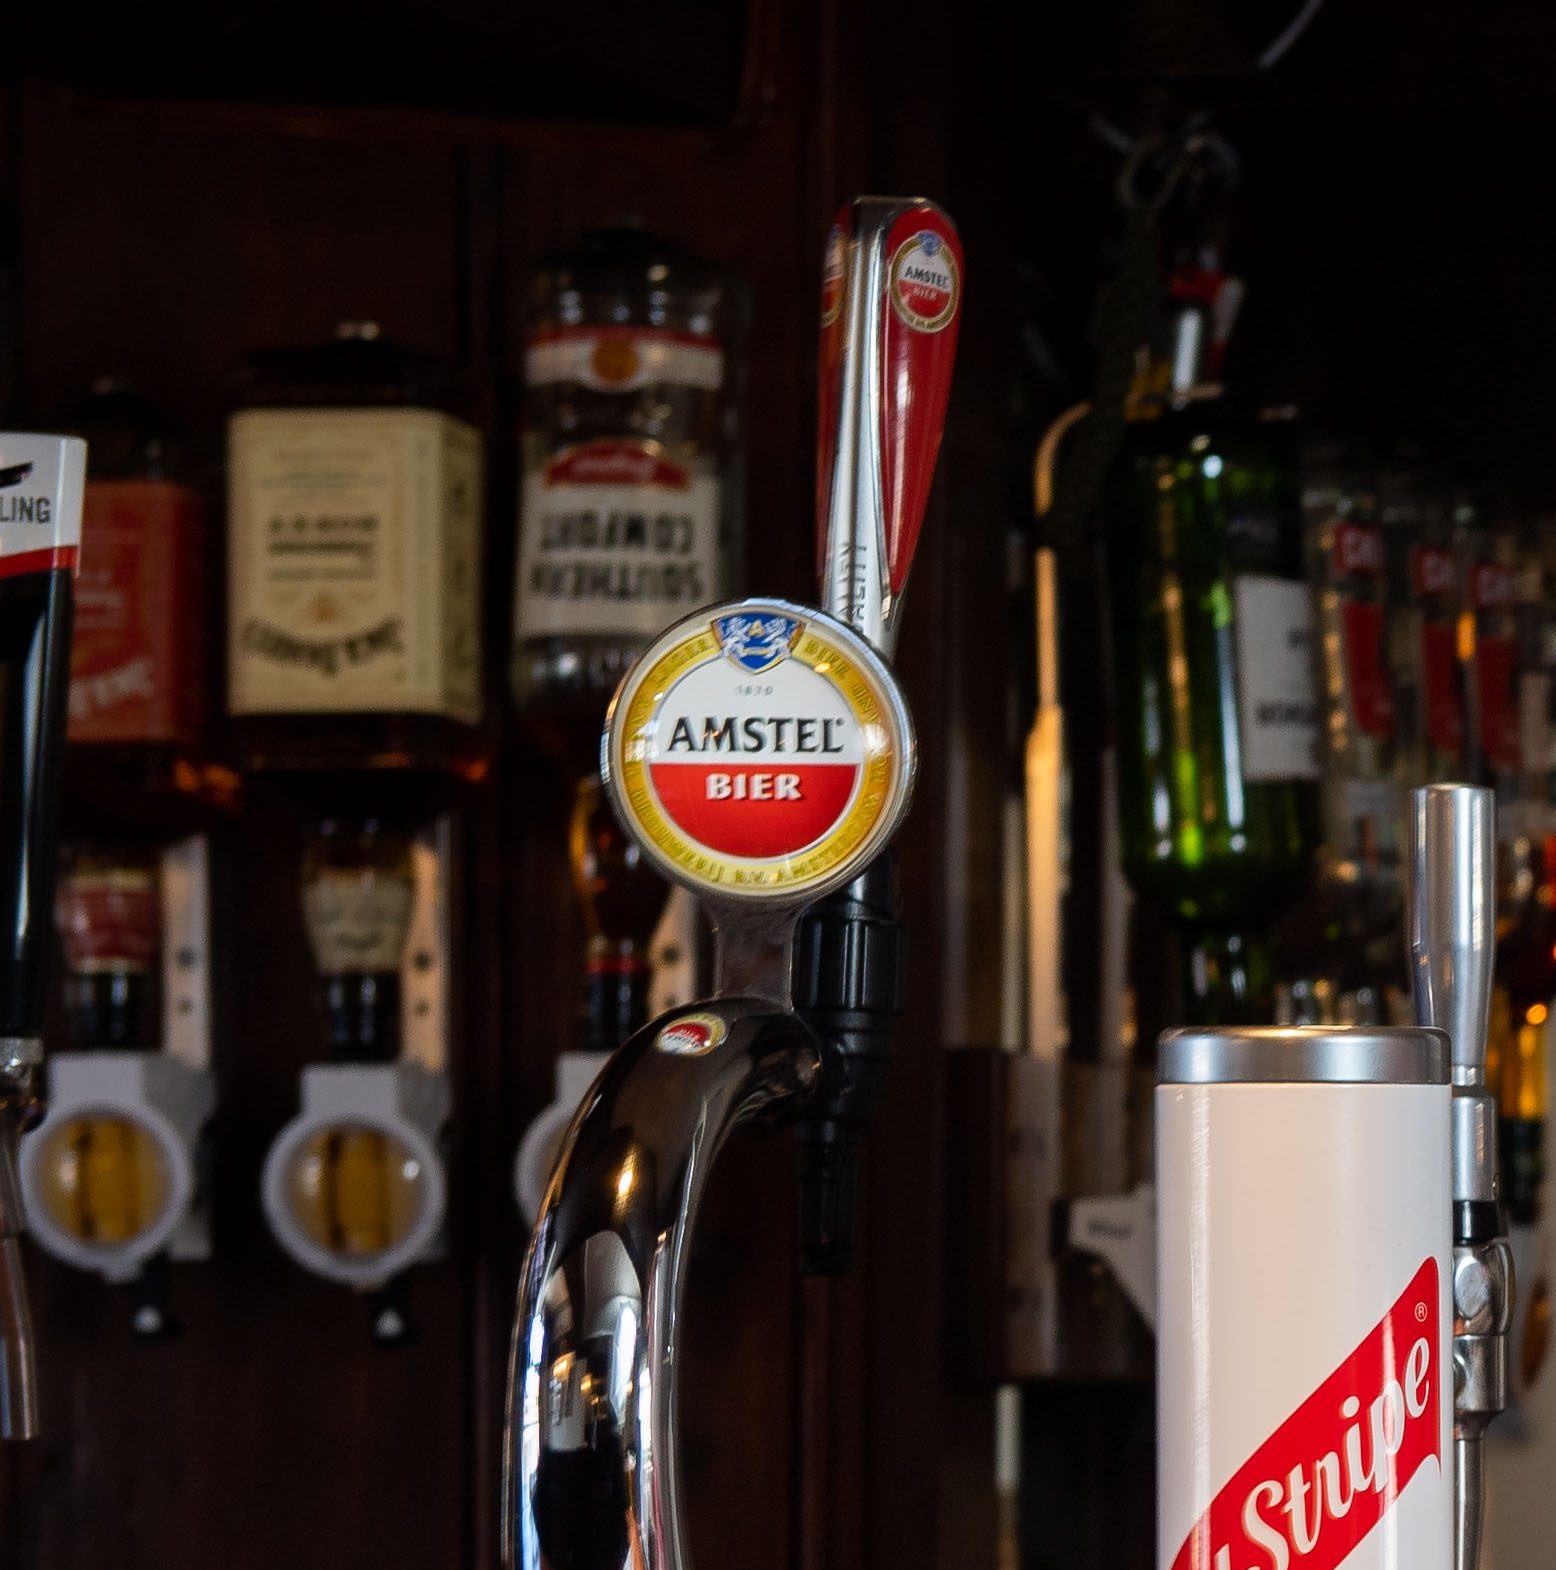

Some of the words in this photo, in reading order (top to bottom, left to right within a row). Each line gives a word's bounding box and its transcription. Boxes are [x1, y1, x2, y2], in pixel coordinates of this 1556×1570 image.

[905, 266, 949, 289] AMSTEL
[666, 716, 845, 754] AMSTEL
[705, 772, 803, 801] BIER
